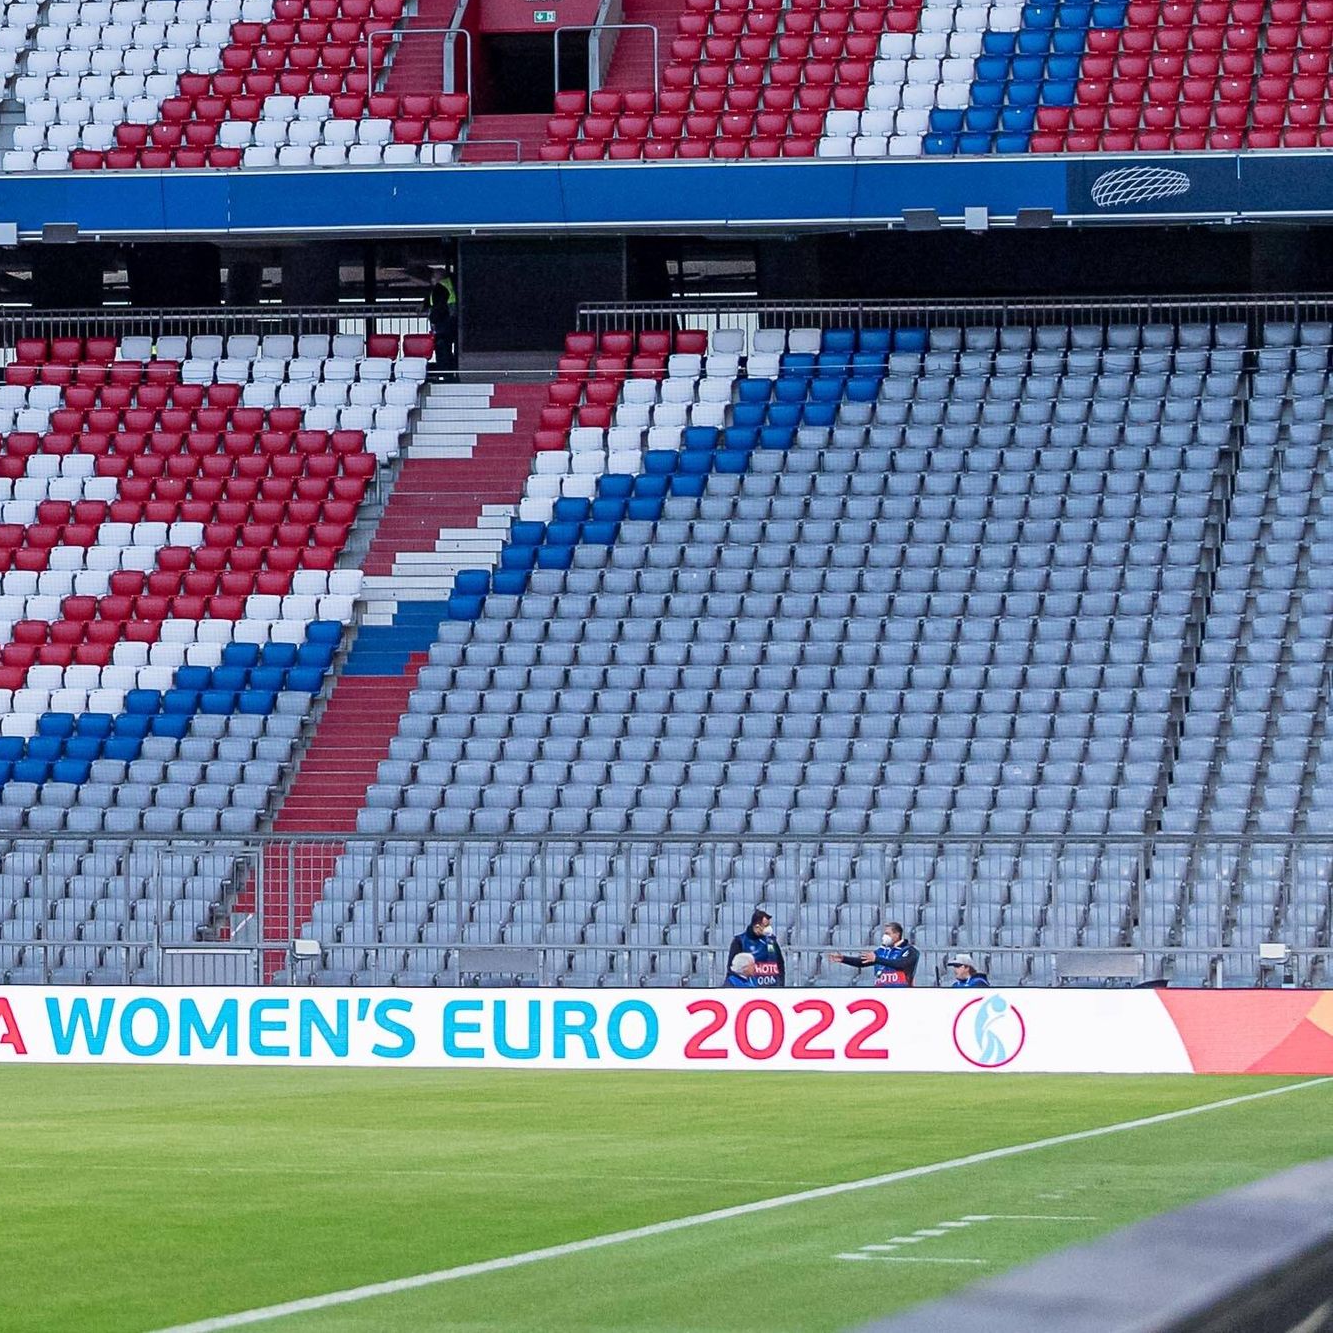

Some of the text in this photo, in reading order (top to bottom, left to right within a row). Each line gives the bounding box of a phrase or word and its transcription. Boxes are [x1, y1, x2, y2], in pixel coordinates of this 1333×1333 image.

[46, 997, 416, 1059] WOMEN'S
[442, 999, 659, 1061] EURO
[684, 999, 890, 1061] 2022
